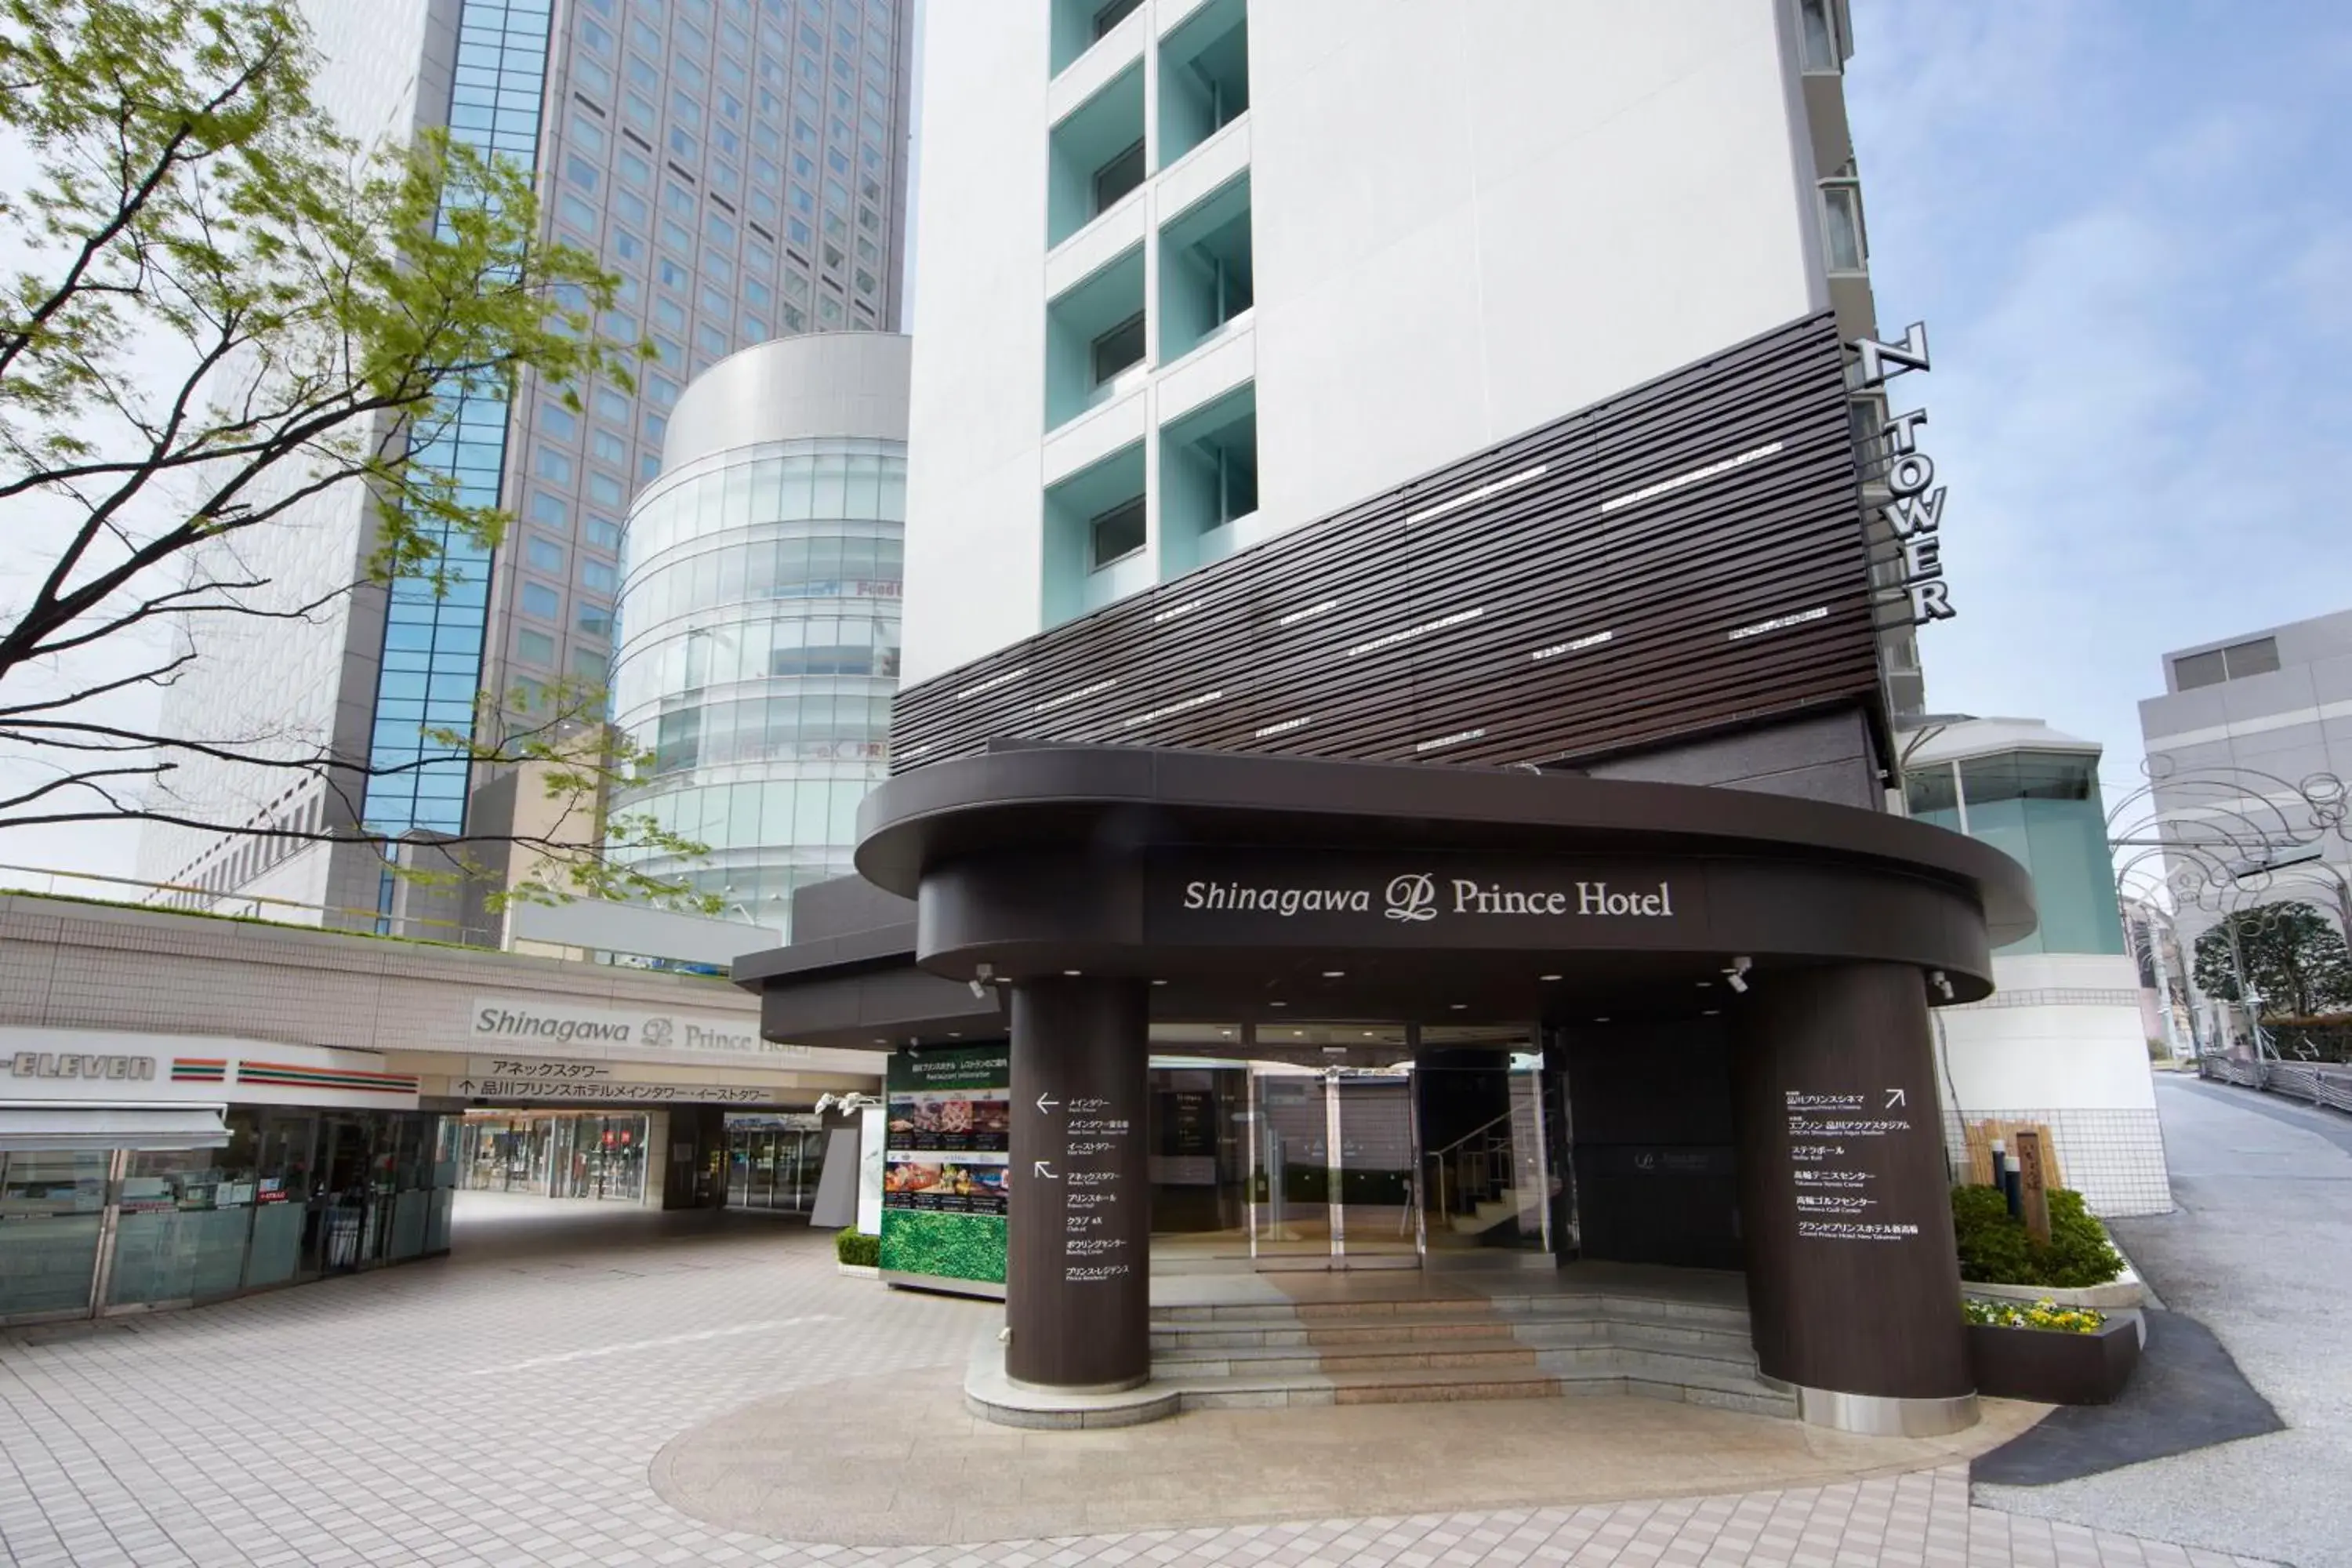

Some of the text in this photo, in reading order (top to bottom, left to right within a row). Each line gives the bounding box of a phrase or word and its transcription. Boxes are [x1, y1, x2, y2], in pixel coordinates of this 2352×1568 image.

[1880, 407, 1957, 626] TOWER
[1184, 881, 1370, 916] Shinagawa
[1452, 879, 1566, 916] Prince
[1576, 881, 1674, 916] Hotel
[476, 1007, 631, 1043] Shinagawa
[684, 1023, 752, 1051] Prince
[492, 1060, 609, 1078] アネックスタワー
